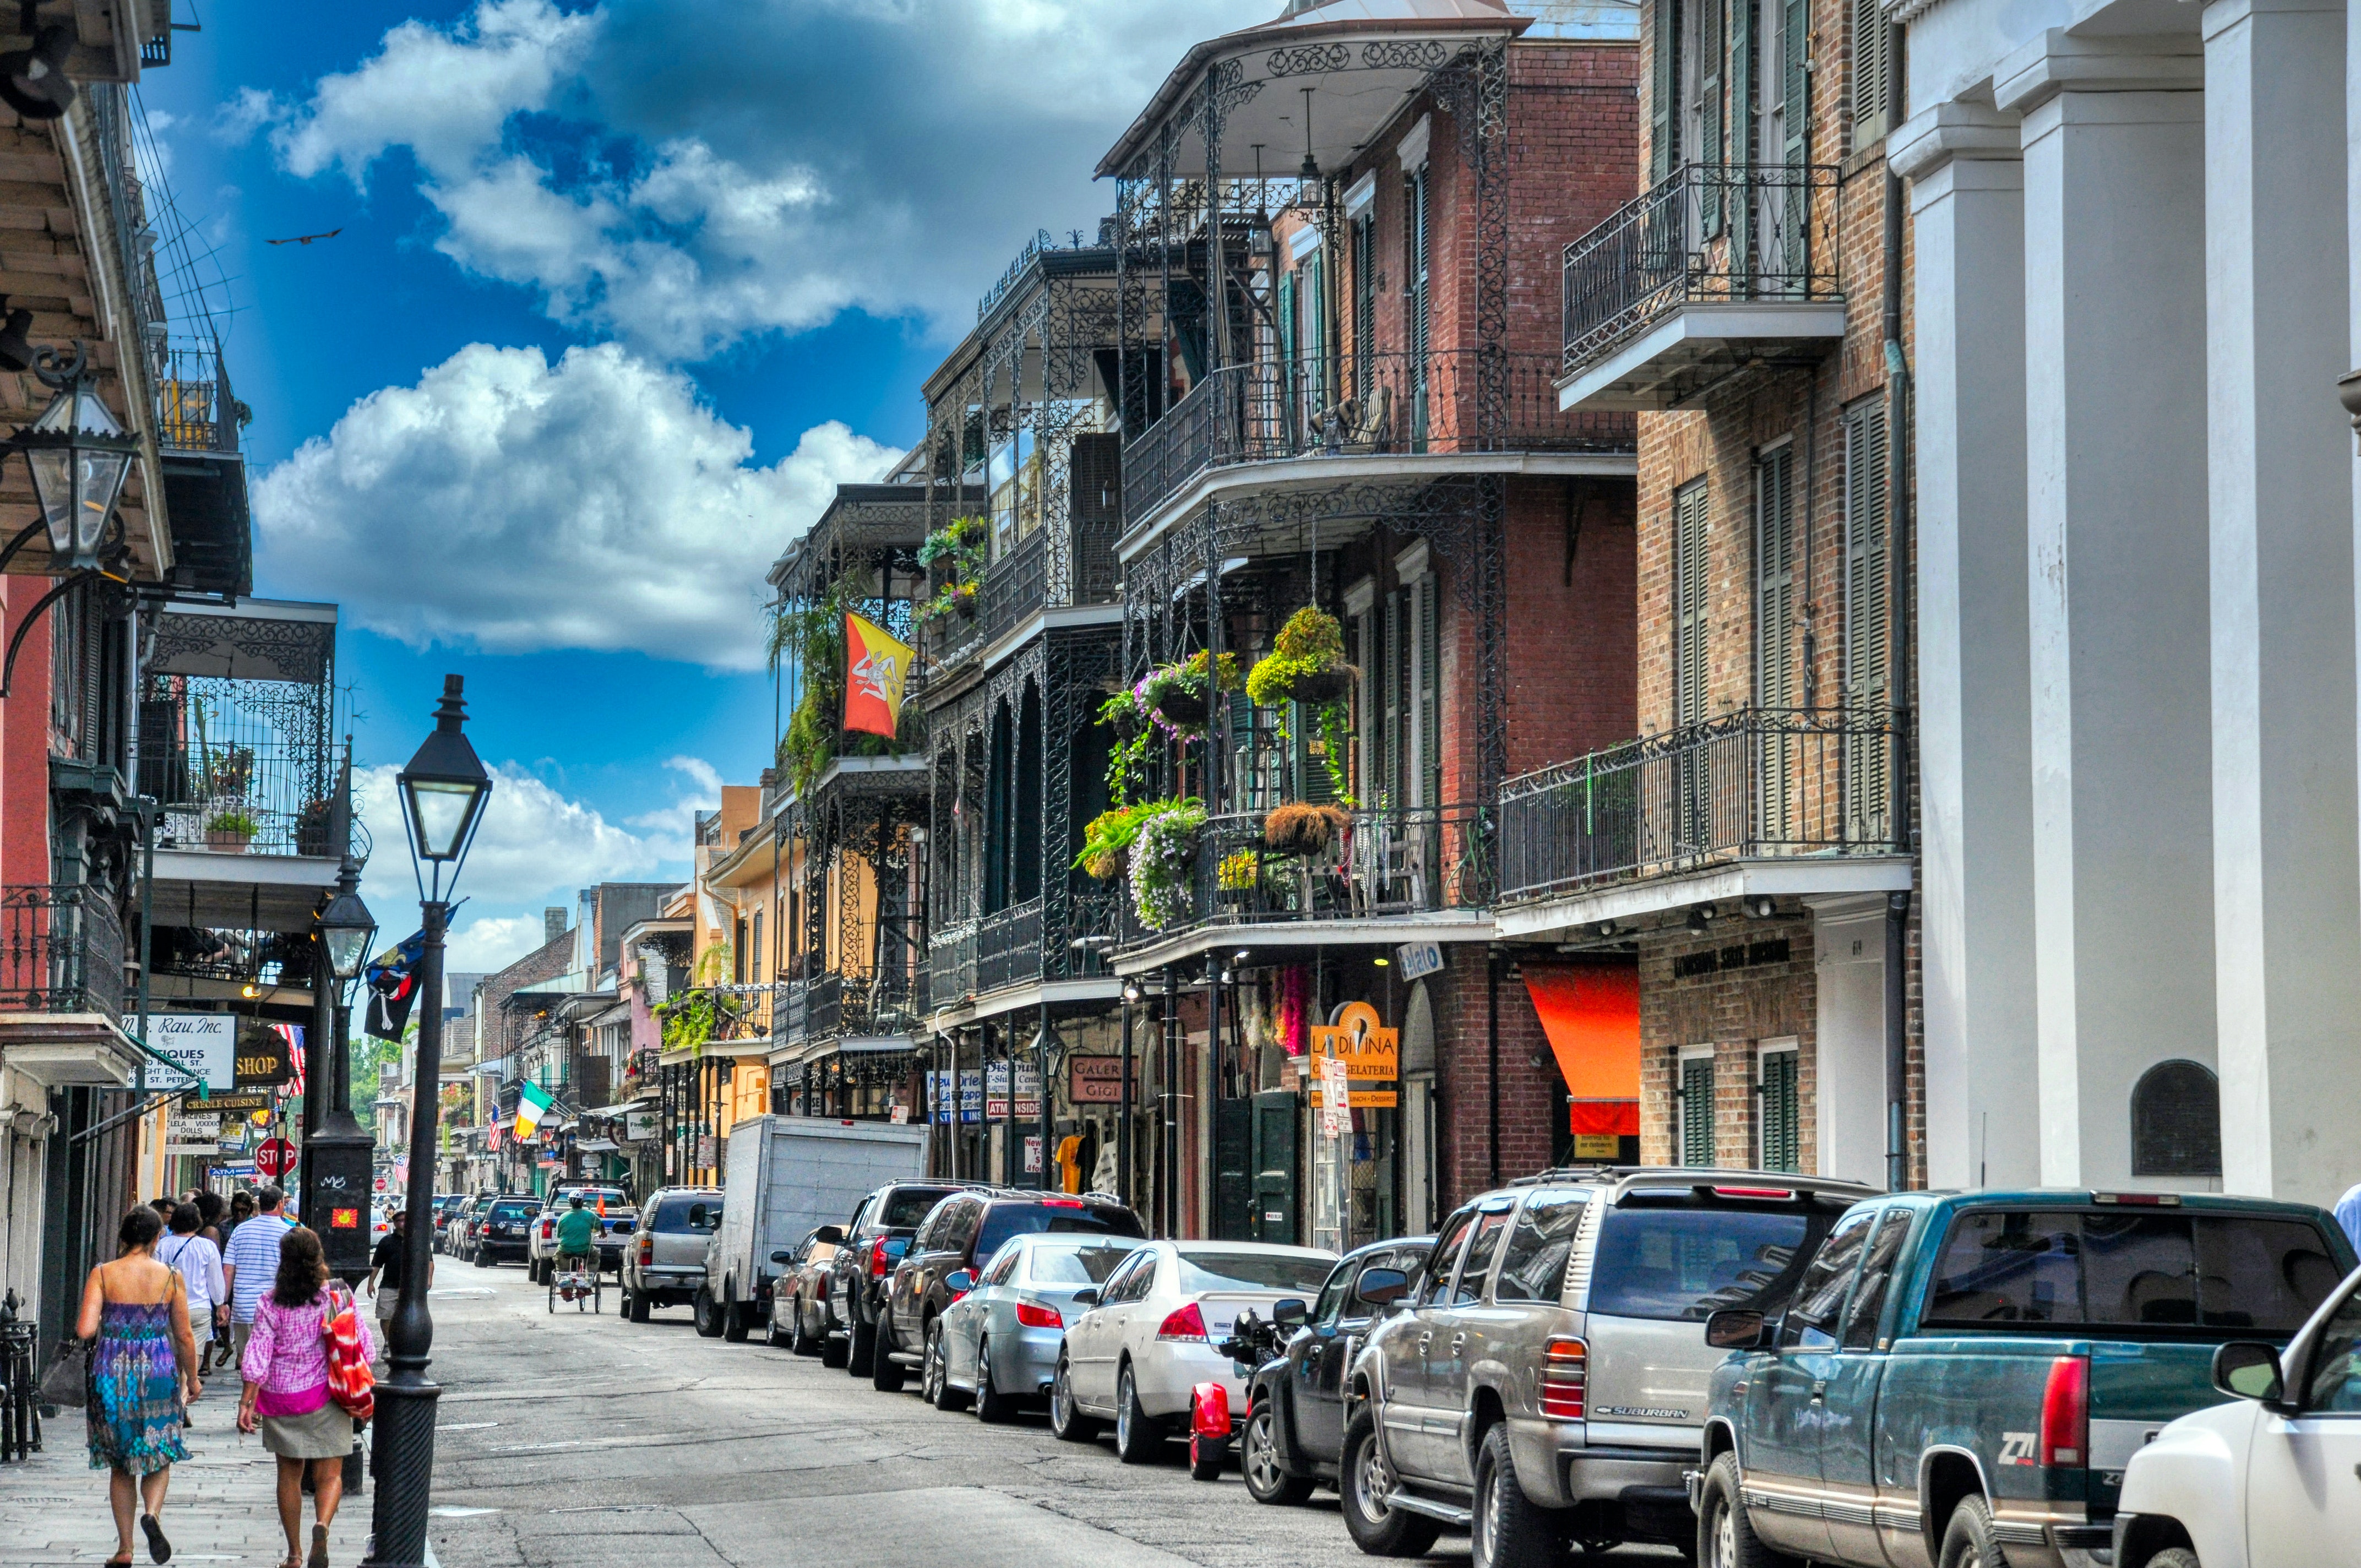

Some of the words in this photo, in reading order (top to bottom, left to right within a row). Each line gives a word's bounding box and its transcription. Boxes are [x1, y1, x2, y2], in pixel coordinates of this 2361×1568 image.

[197, 1017, 221, 1033] Inc.
[236, 1057, 279, 1075] SHOP
[186, 1100, 222, 1109] CREOLE
[224, 1098, 262, 1108] CUISINE
[989, 1103, 1008, 1113] ATM
[1015, 1103, 1041, 1113] NSIDE
[259, 1150, 294, 1164] STP
[1613, 1406, 1689, 1418] SUBURBAN
[1998, 1432, 2036, 1464] Z71
